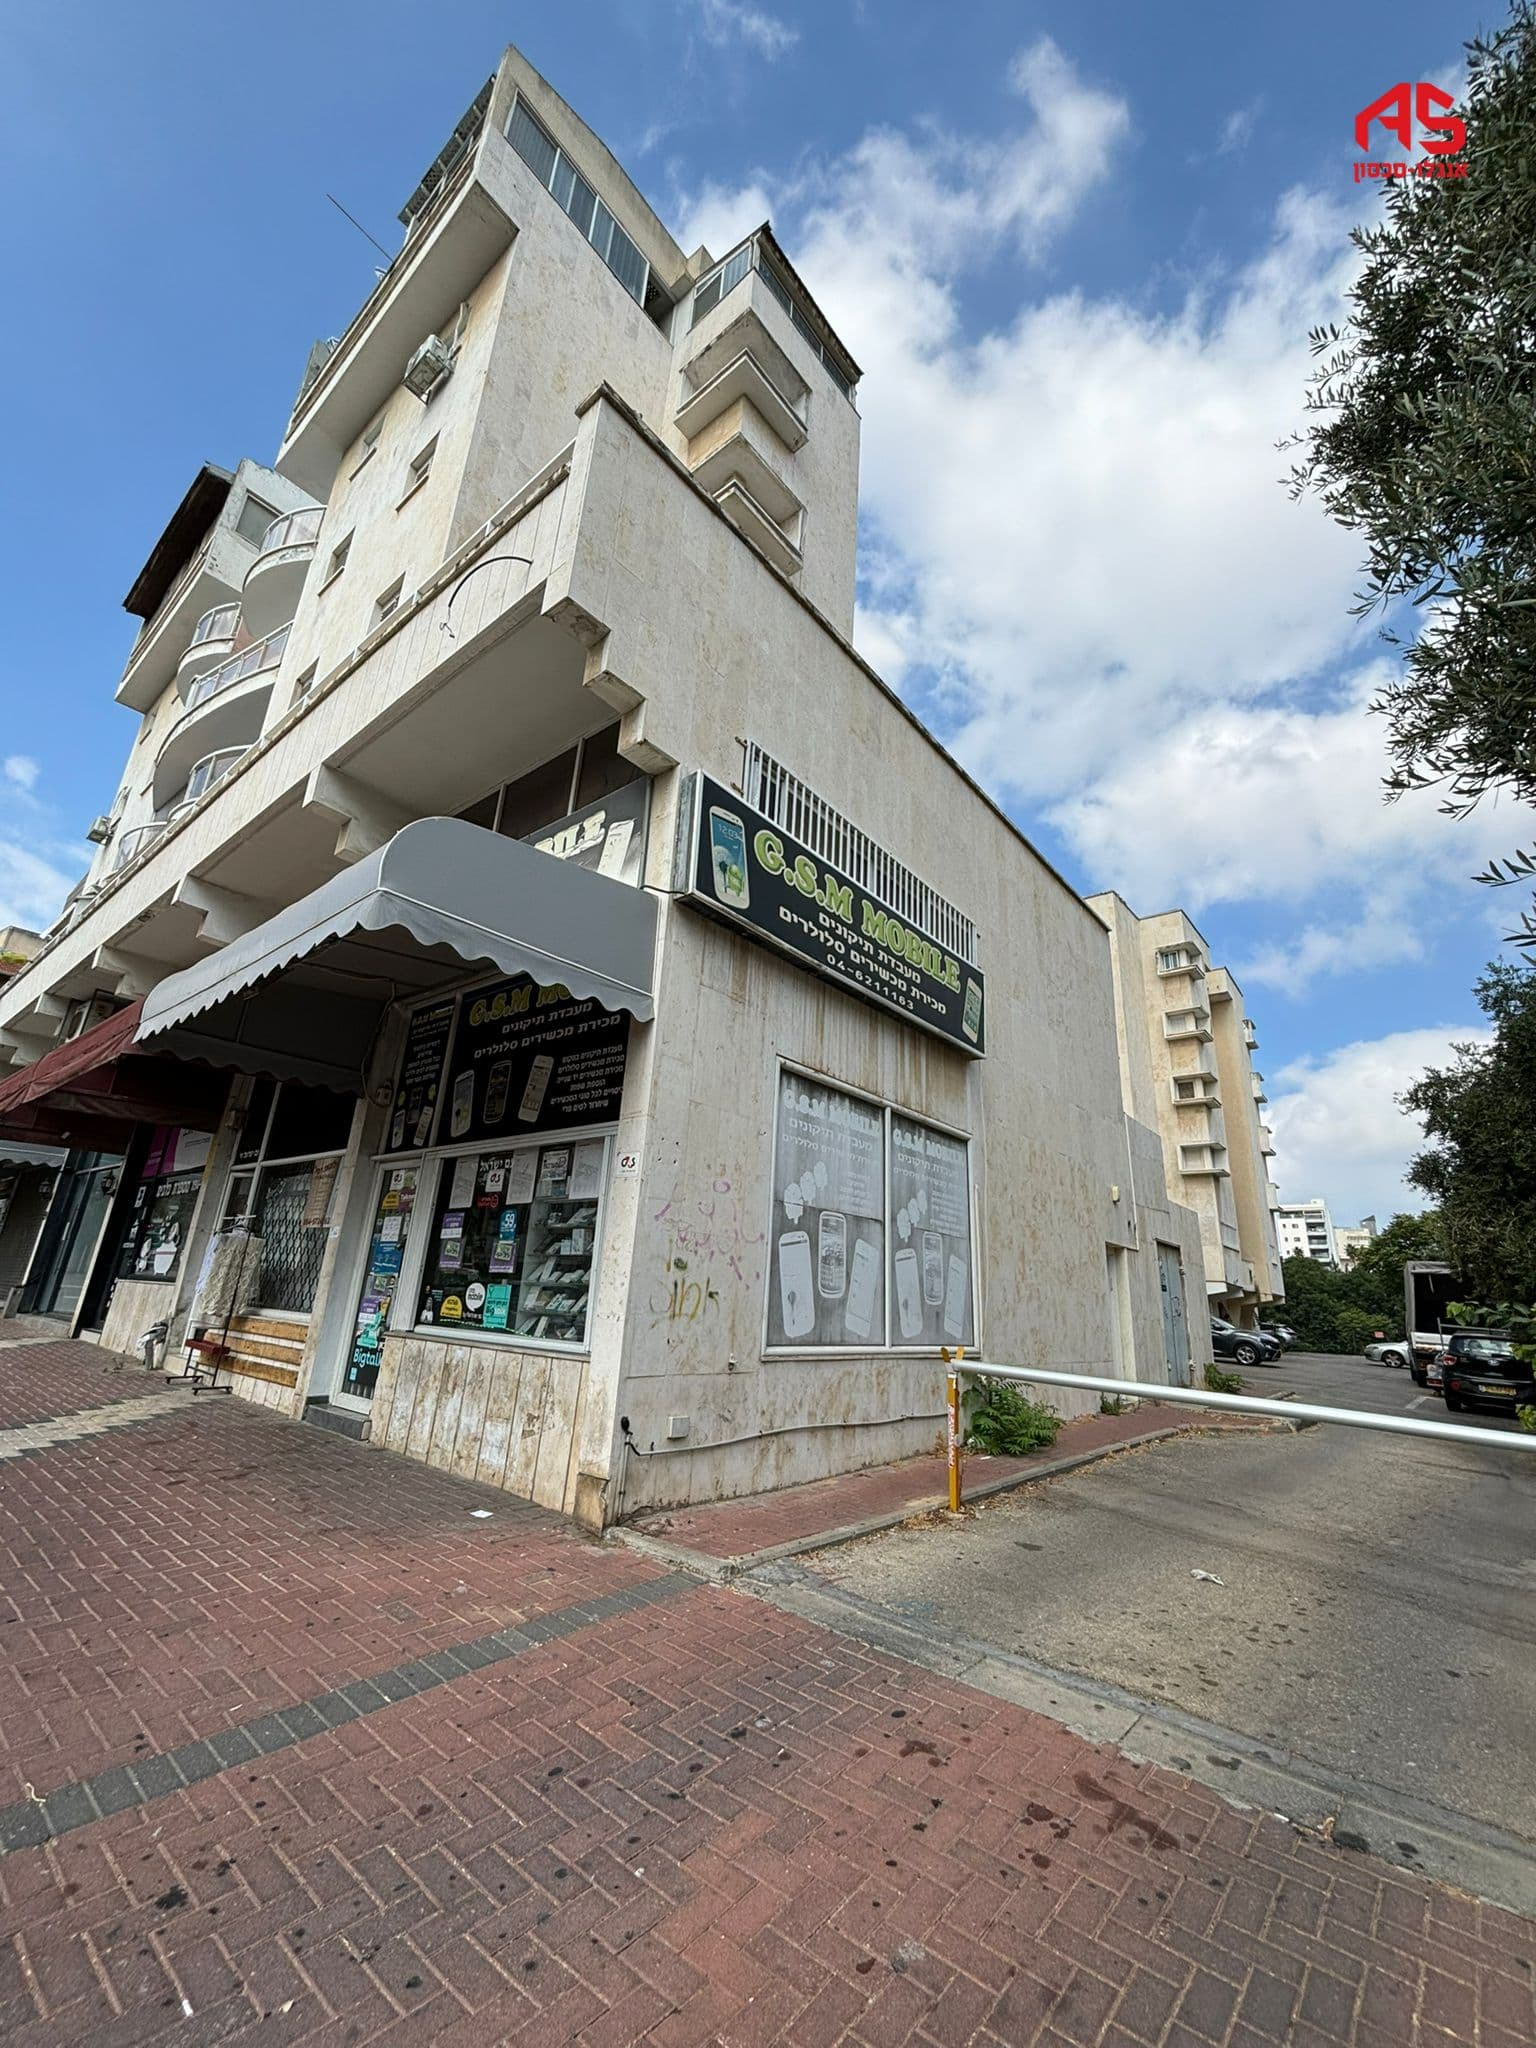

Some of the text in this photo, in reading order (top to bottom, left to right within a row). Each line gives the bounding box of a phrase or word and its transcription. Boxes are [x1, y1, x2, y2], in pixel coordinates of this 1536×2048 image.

[754, 829, 961, 994] G.S.M MOBILE
[778, 905, 947, 1015] מכירת מכשירים סלולרים
[818, 911, 921, 984] מעבדת תיקונים
[469, 984, 533, 1026] G.S.M
[826, 953, 914, 1010] 04-6211163
[473, 1013, 621, 1059] מכירת מכשירים סלולרים
[501, 1001, 593, 1035] מעבדת תיקונים
